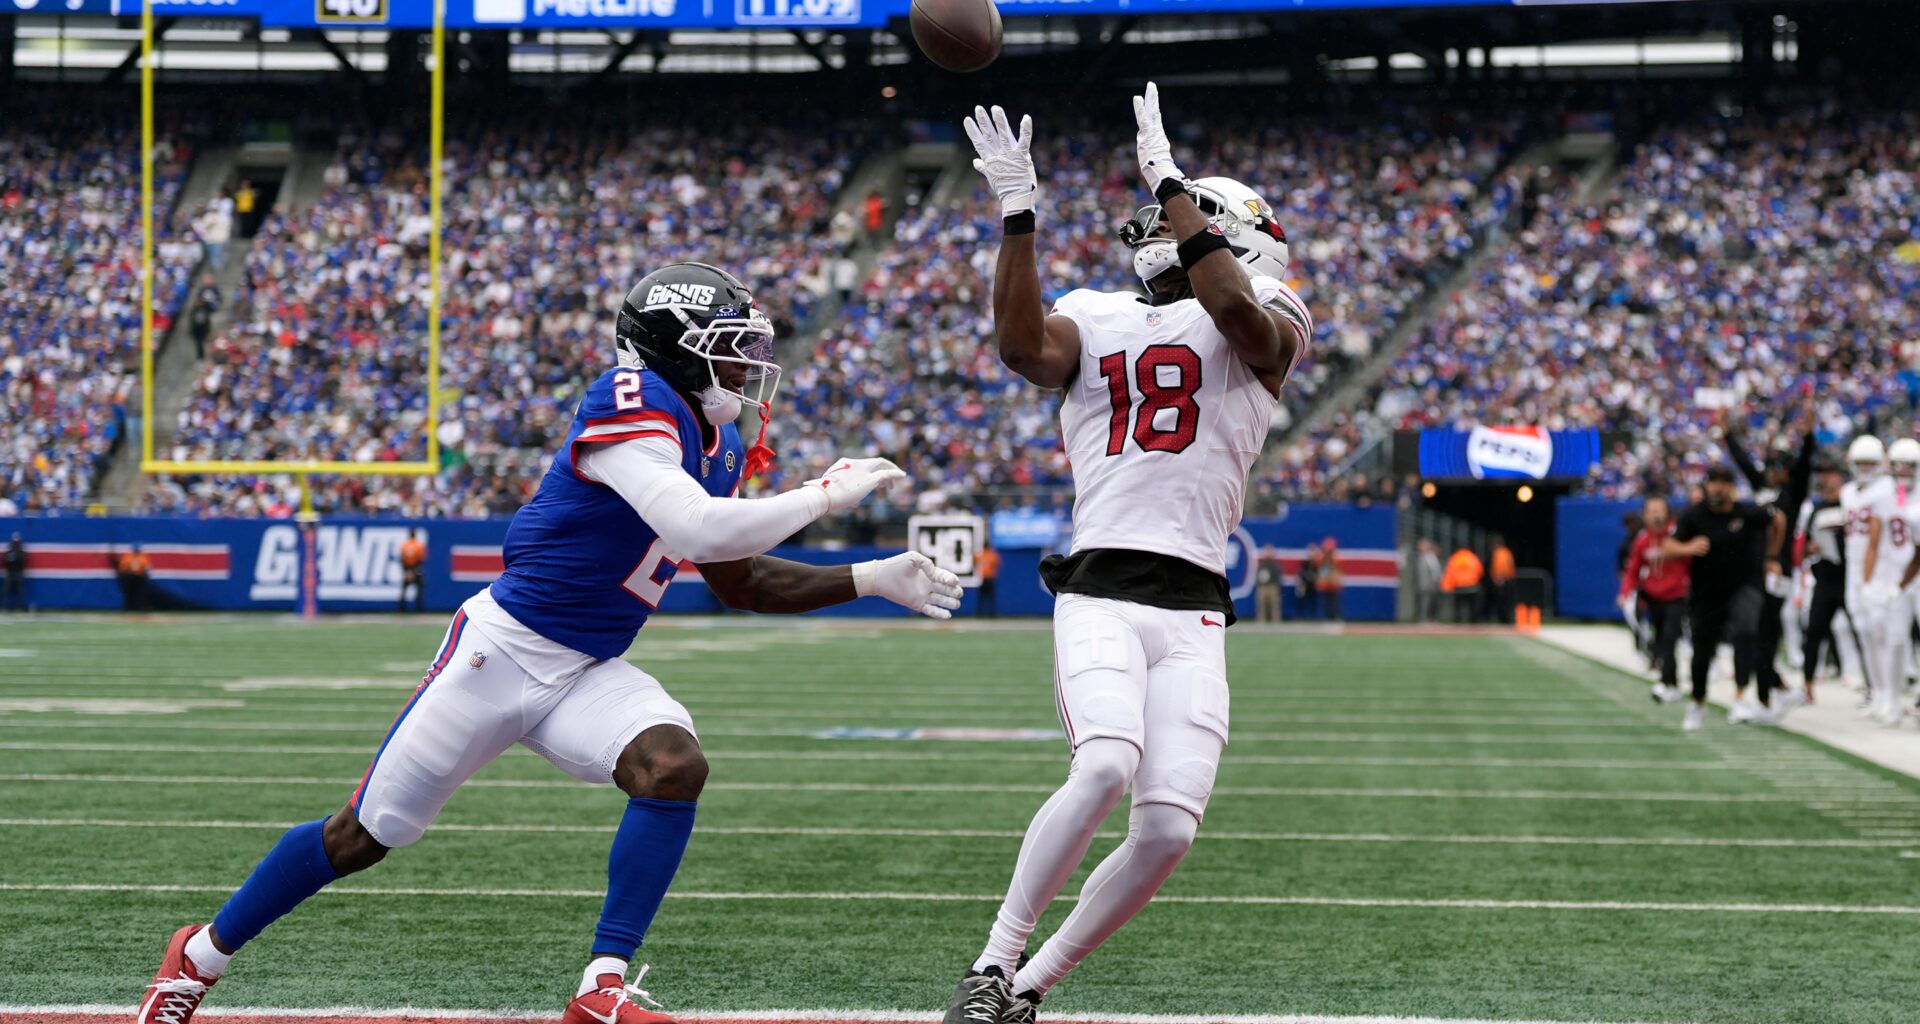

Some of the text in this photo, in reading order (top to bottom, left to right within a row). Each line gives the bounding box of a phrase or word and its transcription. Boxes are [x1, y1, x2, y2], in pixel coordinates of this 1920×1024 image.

[646, 284, 716, 306] GIANTS
[613, 371, 643, 411] 2
[1100, 344, 1202, 456] 18
[918, 527, 974, 575] 40
